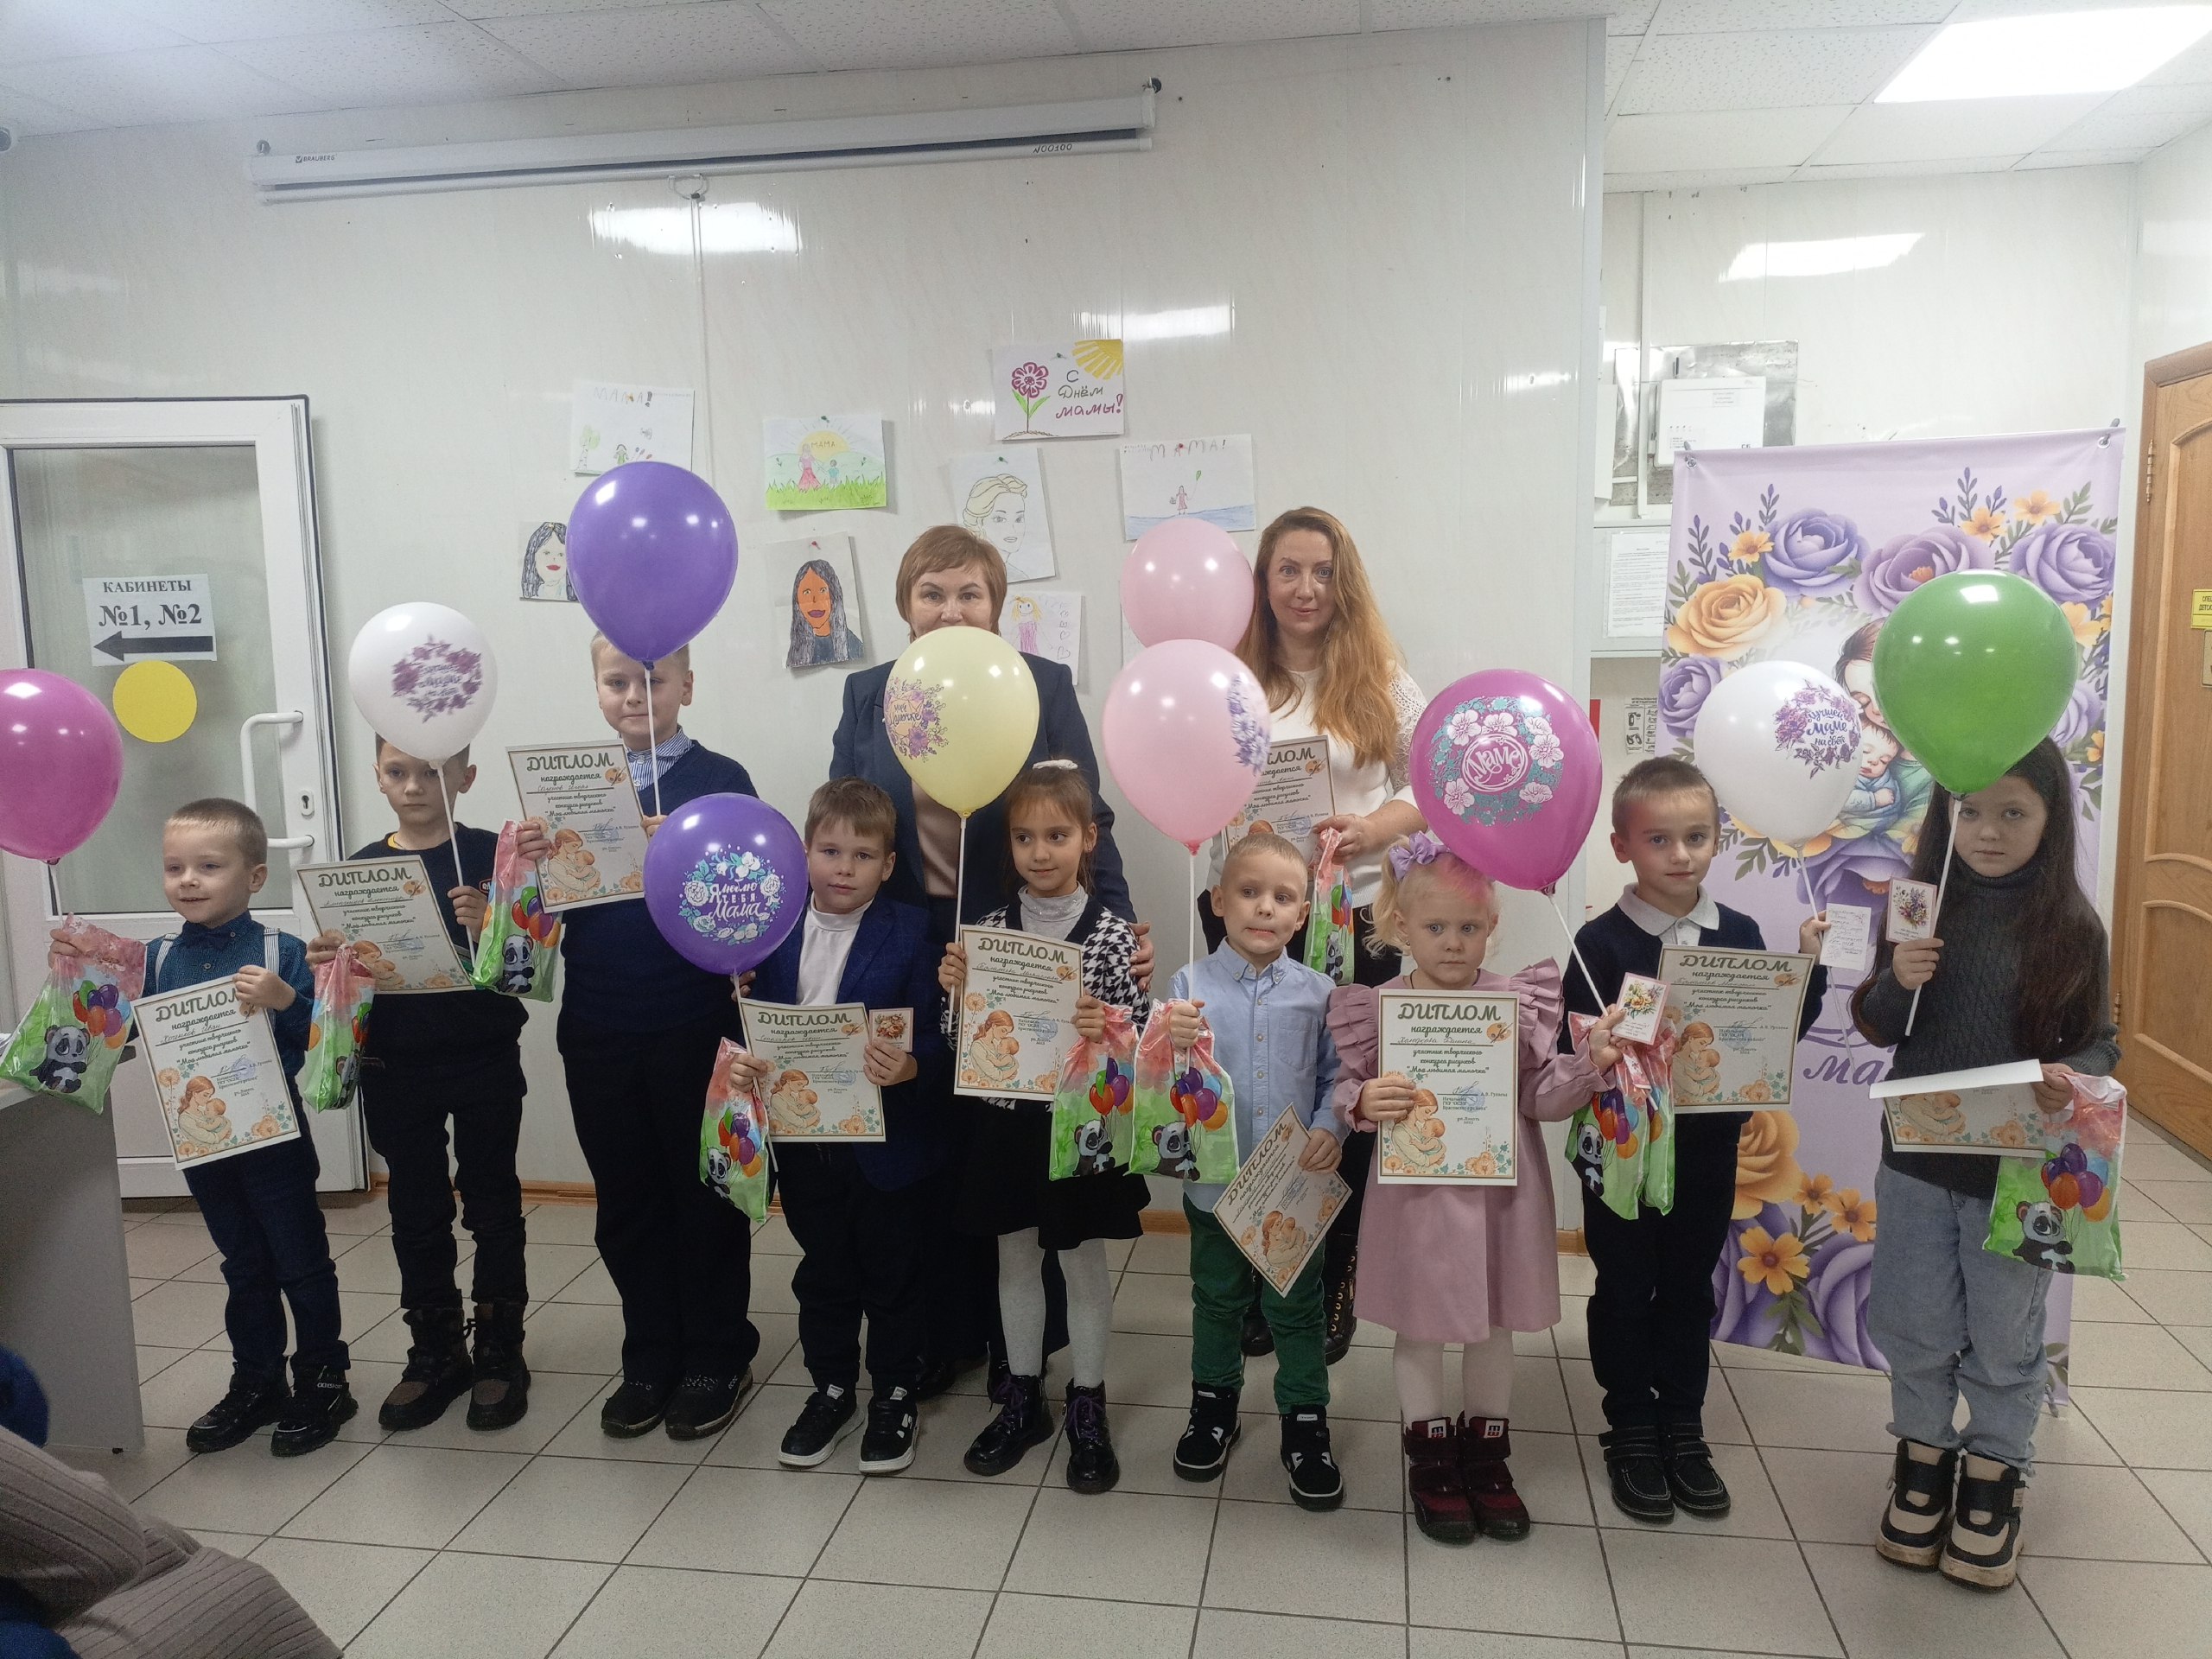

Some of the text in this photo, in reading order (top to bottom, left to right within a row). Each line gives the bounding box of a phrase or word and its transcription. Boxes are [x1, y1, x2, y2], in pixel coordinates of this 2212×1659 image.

[1066, 370, 1079, 383] С
[1058, 385, 1104, 399] Днём
[811, 441, 836, 449] МАМА
[103, 580, 192, 593] КАБИНЕТЫ
[99, 603, 202, 630] №1, №2
[526, 753, 614, 771] ДИПЛОМ
[1267, 747, 1315, 765] ЛОМ
[541, 773, 601, 785] награждается
[1262, 766, 1302, 778] ждается
[318, 868, 412, 887] ДИПЛОМ
[334, 886, 400, 899] награждается
[978, 938, 1068, 964] ДИПЛОМ
[990, 957, 1053, 971] награждается
[1679, 955, 1793, 972] ДИПЛОМ
[1692, 971, 1770, 982] награждается
[1397, 1003, 1502, 1020] ДИПЛОМ
[172, 1009, 236, 1031] награждается
[758, 1012, 852, 1027] ДИПЛОМ
[771, 1027, 837, 1038] награждается
[1411, 1027, 1483, 1038] награждается
[1227, 1123, 1287, 1205] ДИПЛОМ
